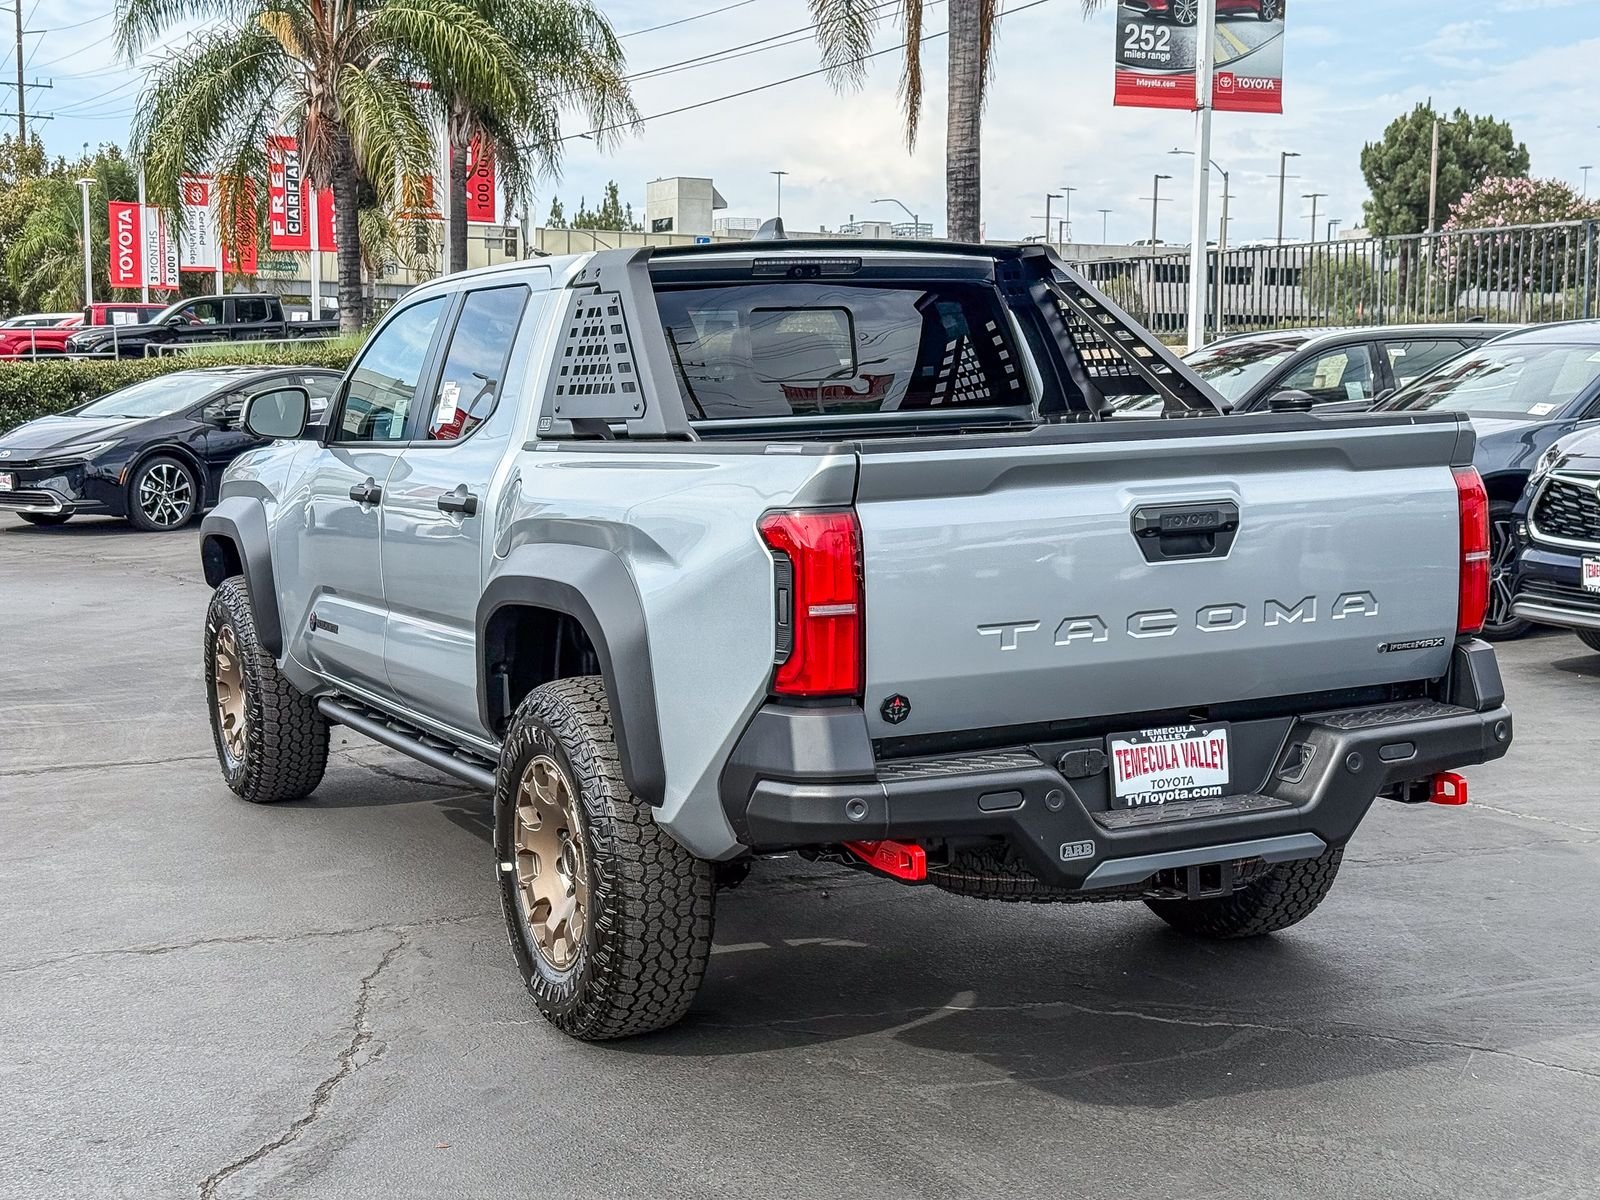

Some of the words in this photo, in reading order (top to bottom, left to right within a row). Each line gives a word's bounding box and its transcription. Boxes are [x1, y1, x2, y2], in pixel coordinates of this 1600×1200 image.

[1124, 23, 1171, 52] 252
[1124, 51, 1146, 60] miles
[1147, 52, 1171, 62] range
[1237, 77, 1275, 91] TOYOTA
[198, 211, 206, 246] Certified
[118, 208, 134, 282] TOYOTA
[149, 230, 159, 275] MONTHS
[189, 232, 198, 265] Vehicles
[167, 256, 177, 283] 3,000
[1165, 512, 1215, 528] TOYOTA
[976, 589, 1379, 652] TACOMA
[1141, 725, 1196, 737] TEMECULA
[1150, 733, 1188, 742] VALLEY
[1115, 743, 1181, 783] TEMECULA
[1180, 738, 1225, 771] VALLEY
[1150, 775, 1195, 790] TOYOTA
[1125, 786, 1222, 806] TVToyota.com
[1064, 843, 1093, 858] ARB
